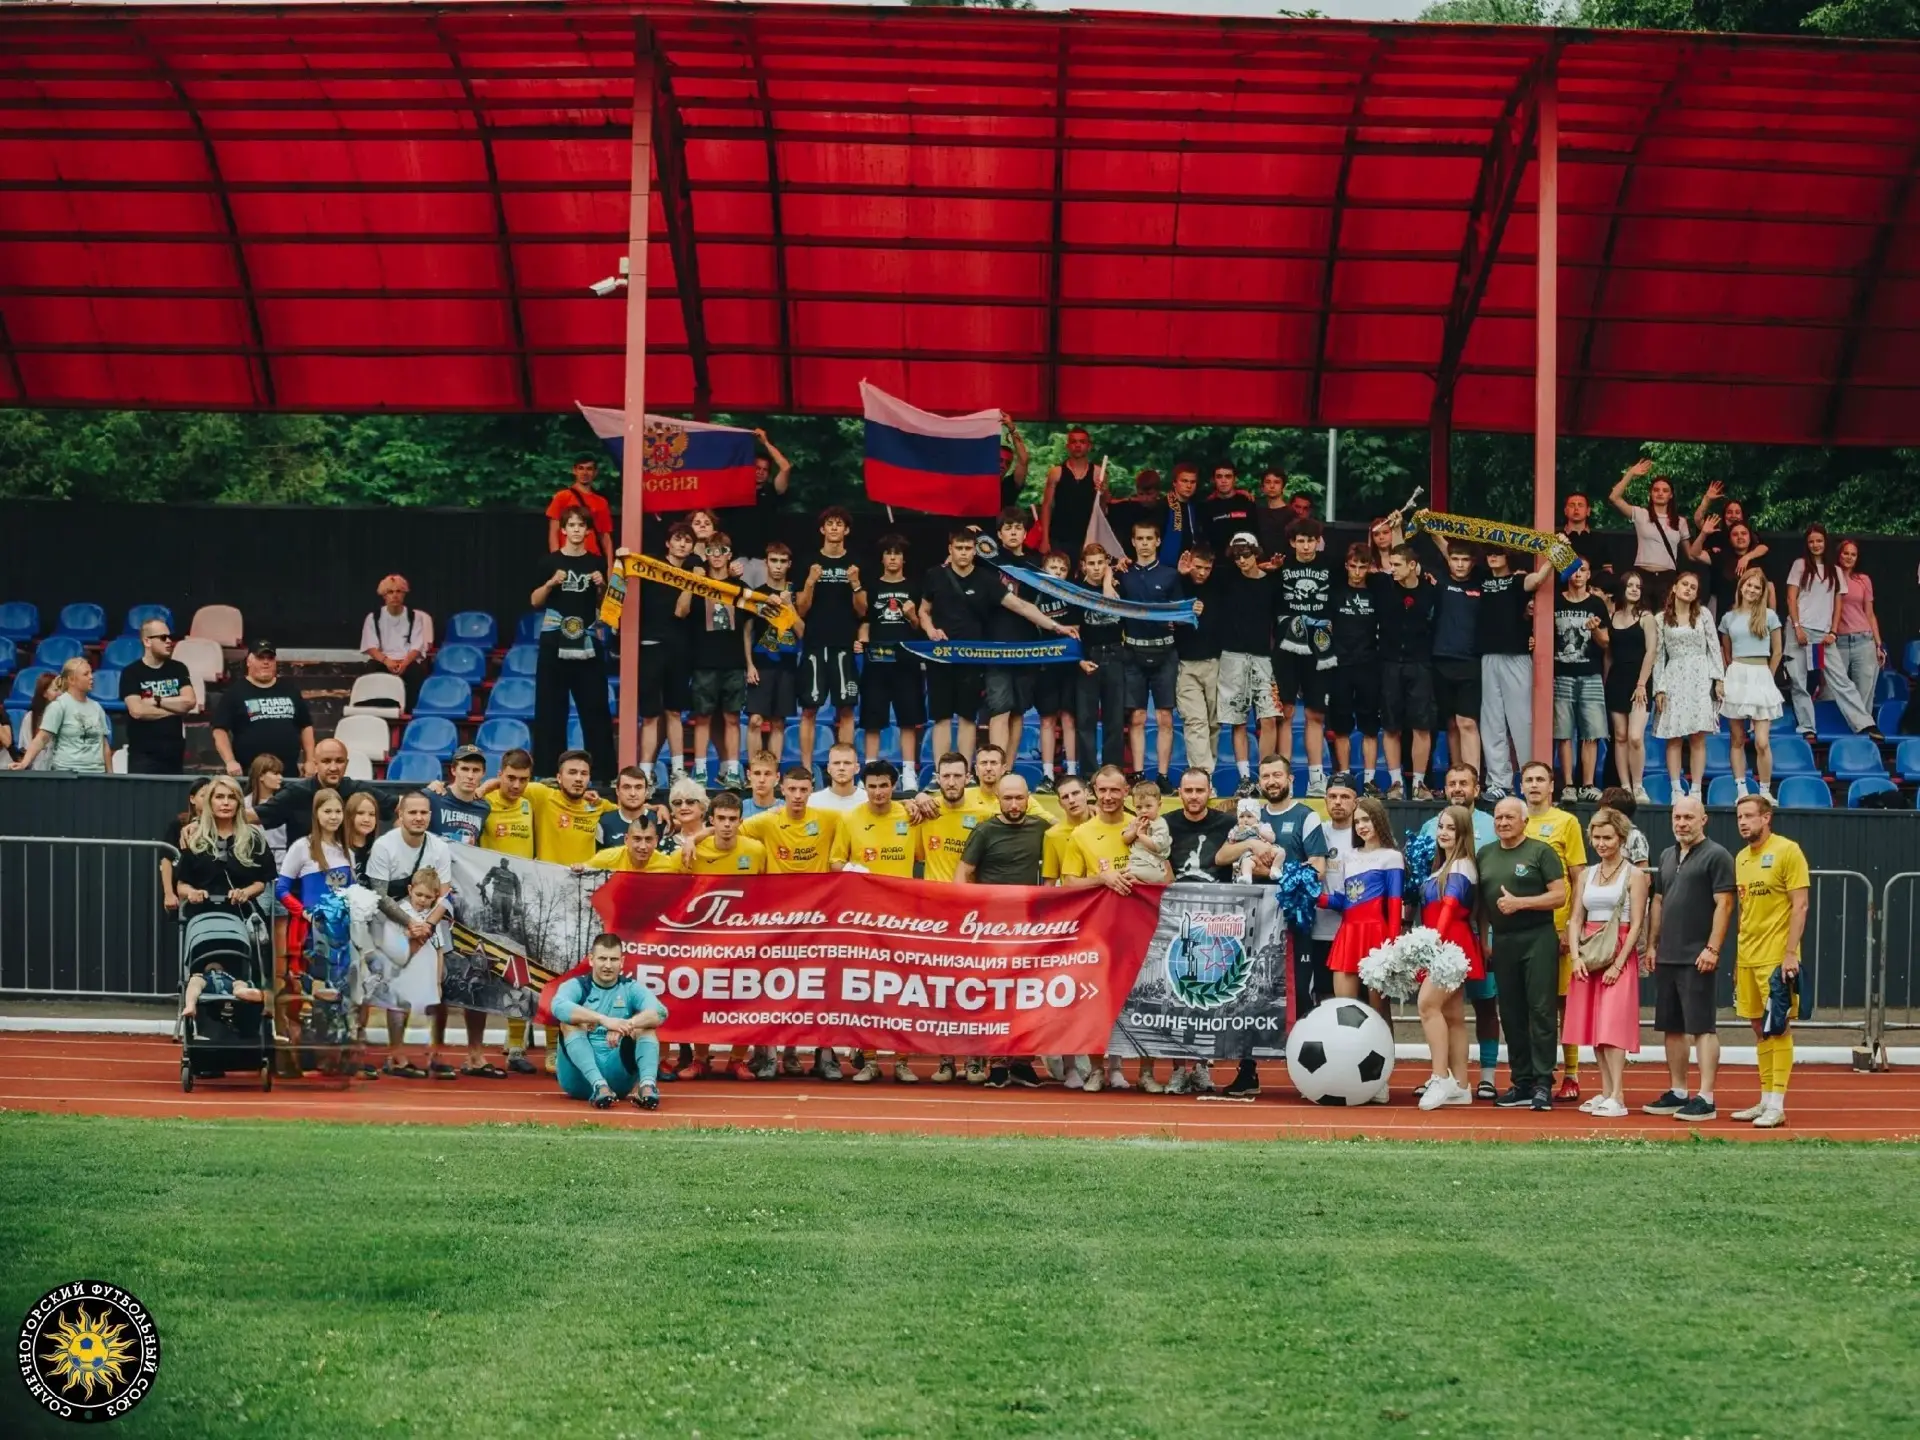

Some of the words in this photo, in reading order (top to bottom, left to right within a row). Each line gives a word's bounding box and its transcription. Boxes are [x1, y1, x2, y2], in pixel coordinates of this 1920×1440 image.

[643, 476, 699, 492] ССИЯ
[632, 561, 658, 578] ФК
[932, 646, 952, 657] ФК
[258, 697, 293, 707] СЛАВА
[260, 706, 295, 715] РОССИИ
[794, 846, 816, 854] ДОДО
[943, 846, 965, 854] ПИЦЦ
[658, 890, 828, 928] Память
[837, 910, 949, 934] сильнее
[959, 910, 1080, 944] времени
[759, 945, 890, 962] ОБЩЕСТВЕННАЯ
[893, 951, 1007, 971] ОРГАНИЗАЦИЯ
[1011, 951, 1099, 969] ВЕТЕРАНОВ
[702, 1011, 813, 1025] МОСКОВСКОЕ
[816, 1012, 913, 1032] ОБЛАСТНОЕ
[915, 1019, 1010, 1037] ОТДЕЛЕНИЕ
[1130, 1012, 1279, 1032] СОЛНЕЧНОГОРСК
